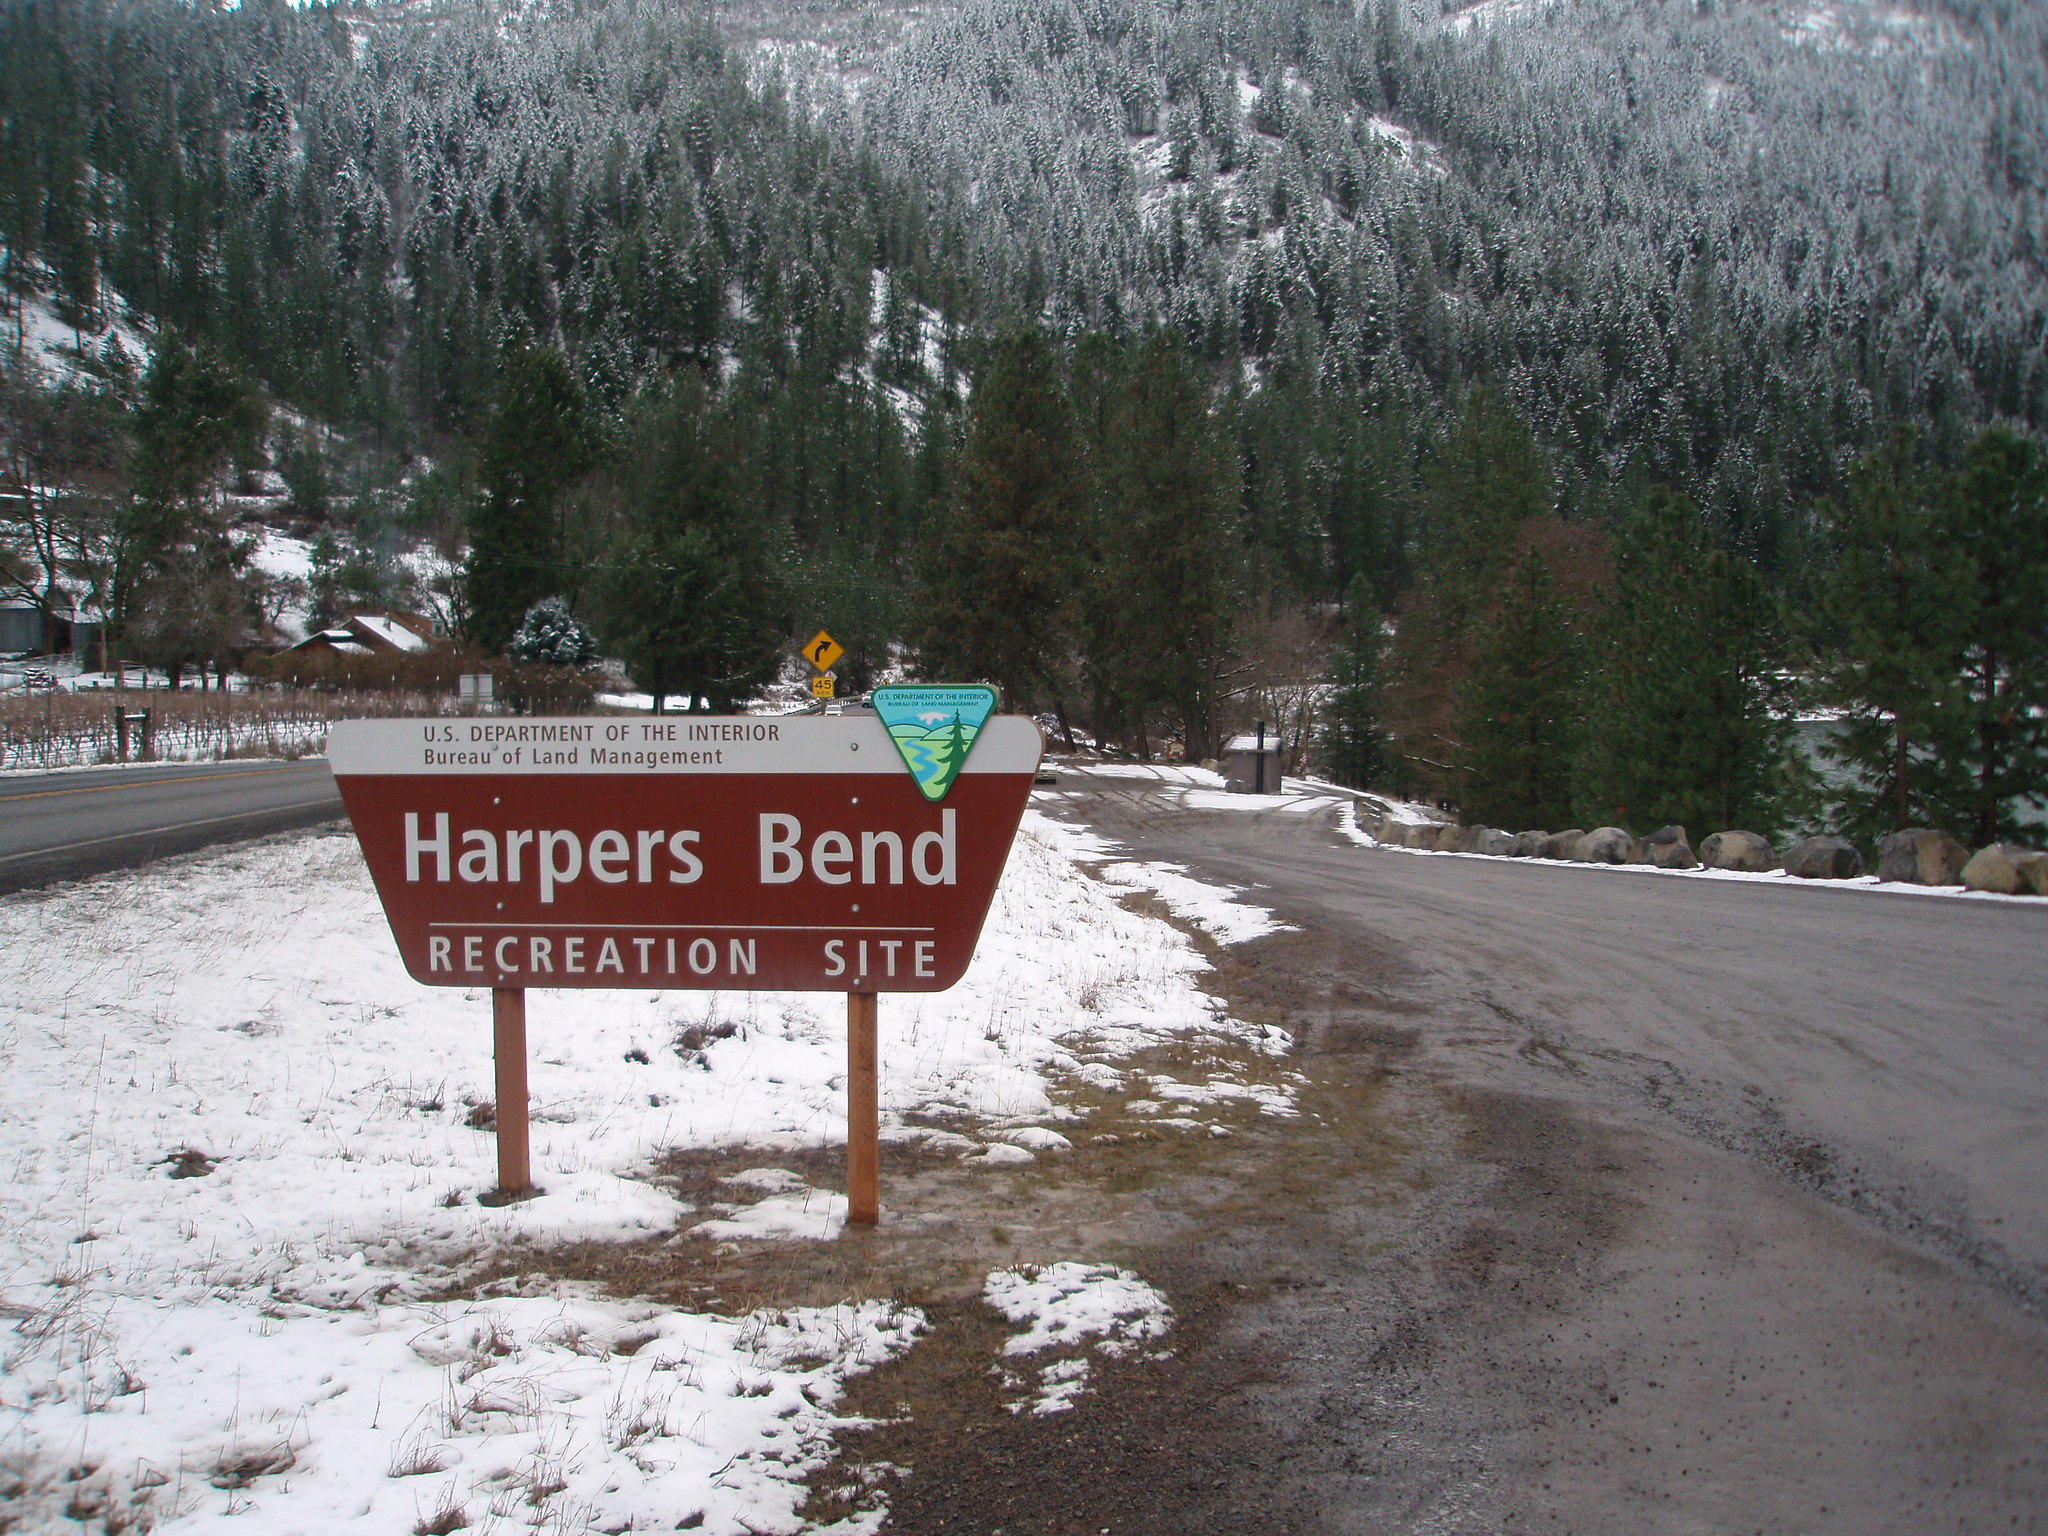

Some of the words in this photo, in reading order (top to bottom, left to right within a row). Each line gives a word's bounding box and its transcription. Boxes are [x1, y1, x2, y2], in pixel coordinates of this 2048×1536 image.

[815, 680, 832, 689] 45
[424, 725, 459, 742] U.S.
[470, 725, 594, 742] DEPARTMENT
[606, 725, 631, 742] OF
[641, 724, 677, 741] THE
[688, 724, 781, 742] INTERIOR
[424, 748, 492, 765] Bureau
[502, 747, 522, 765] of
[533, 748, 579, 765] Land
[590, 748, 723, 768] Management
[404, 812, 703, 902] Harpers
[759, 808, 957, 885] Bend
[429, 936, 756, 974] RECREATION
[824, 939, 935, 977] SITE
